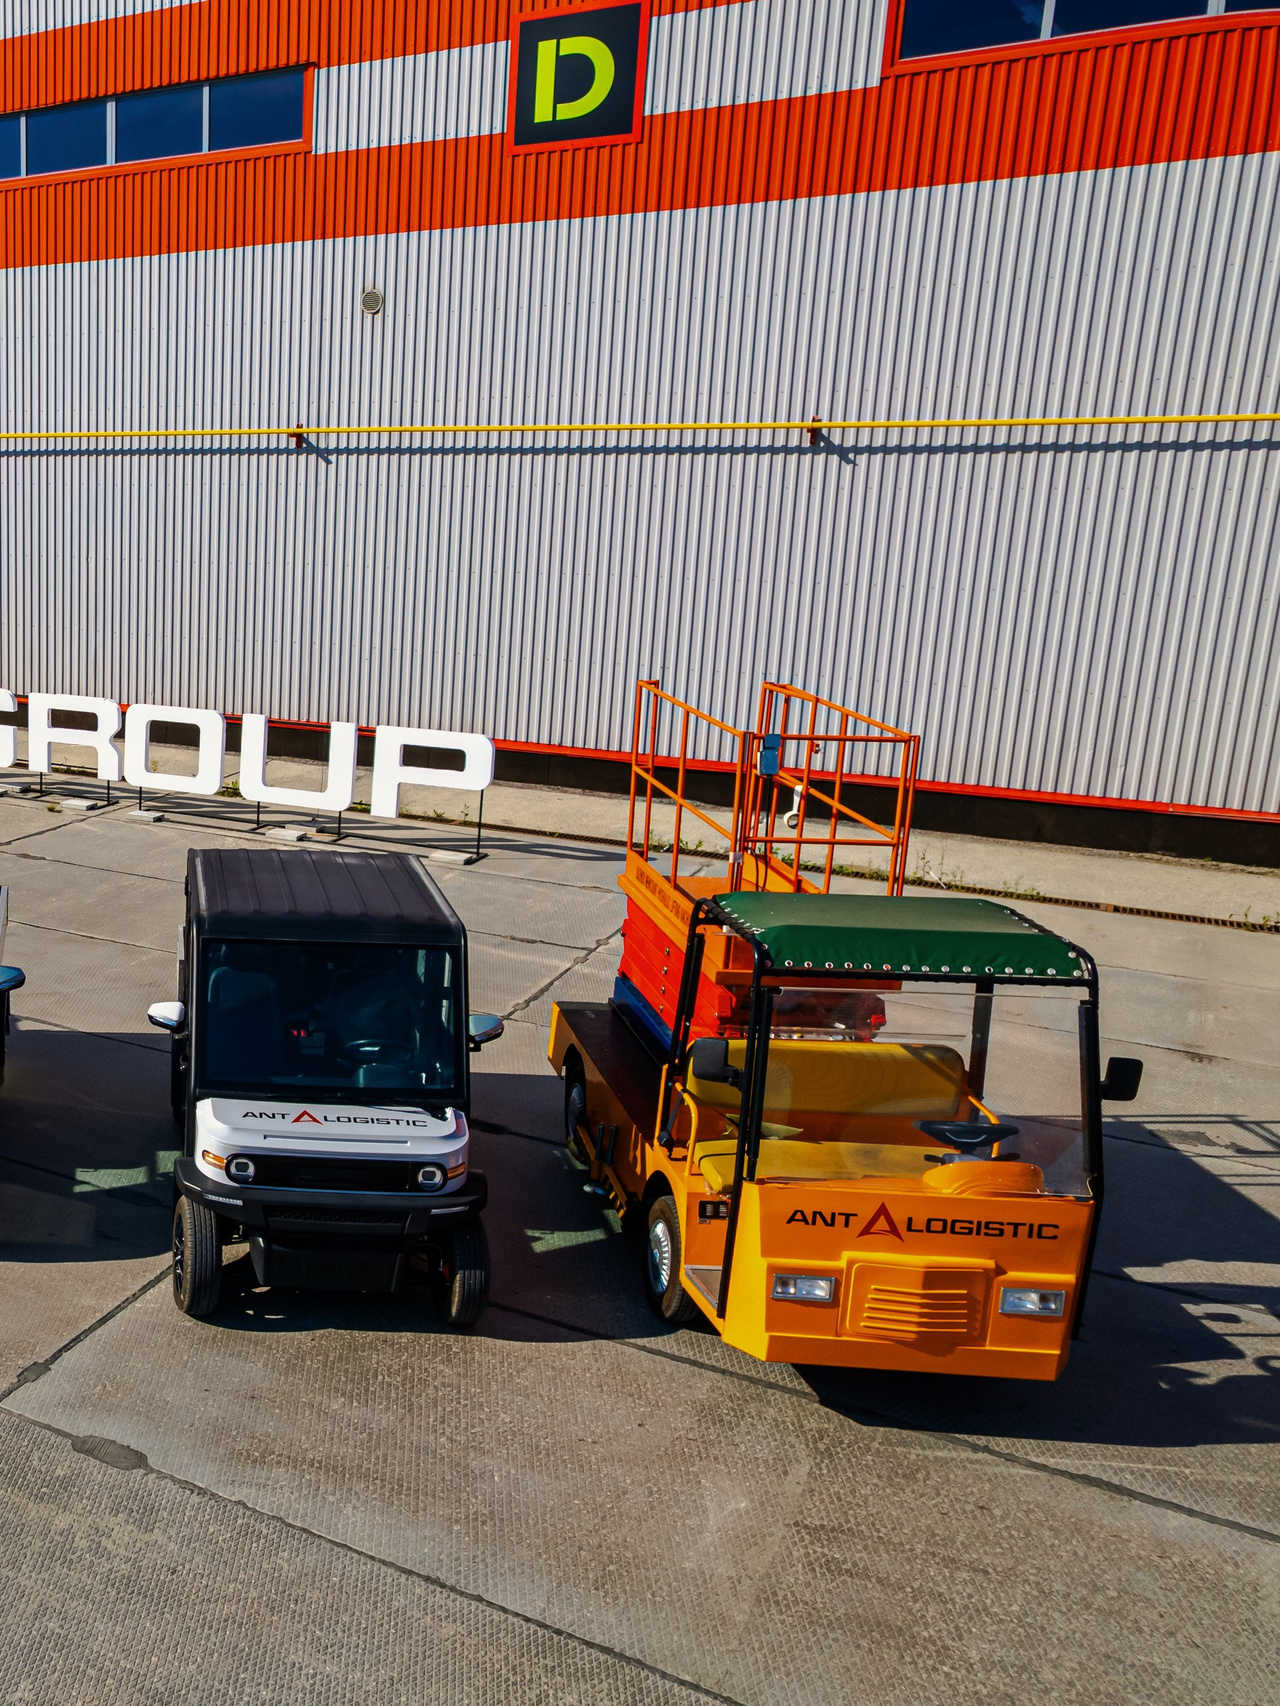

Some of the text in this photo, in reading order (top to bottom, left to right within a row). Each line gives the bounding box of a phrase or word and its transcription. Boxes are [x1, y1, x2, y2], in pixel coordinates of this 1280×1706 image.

[534, 36, 615, 123] D
[242, 1111, 290, 1120] ANT
[324, 1115, 428, 1128] LOGISTIC
[785, 1209, 858, 1228] ANT
[906, 1216, 1060, 1240] LOGISTIC
